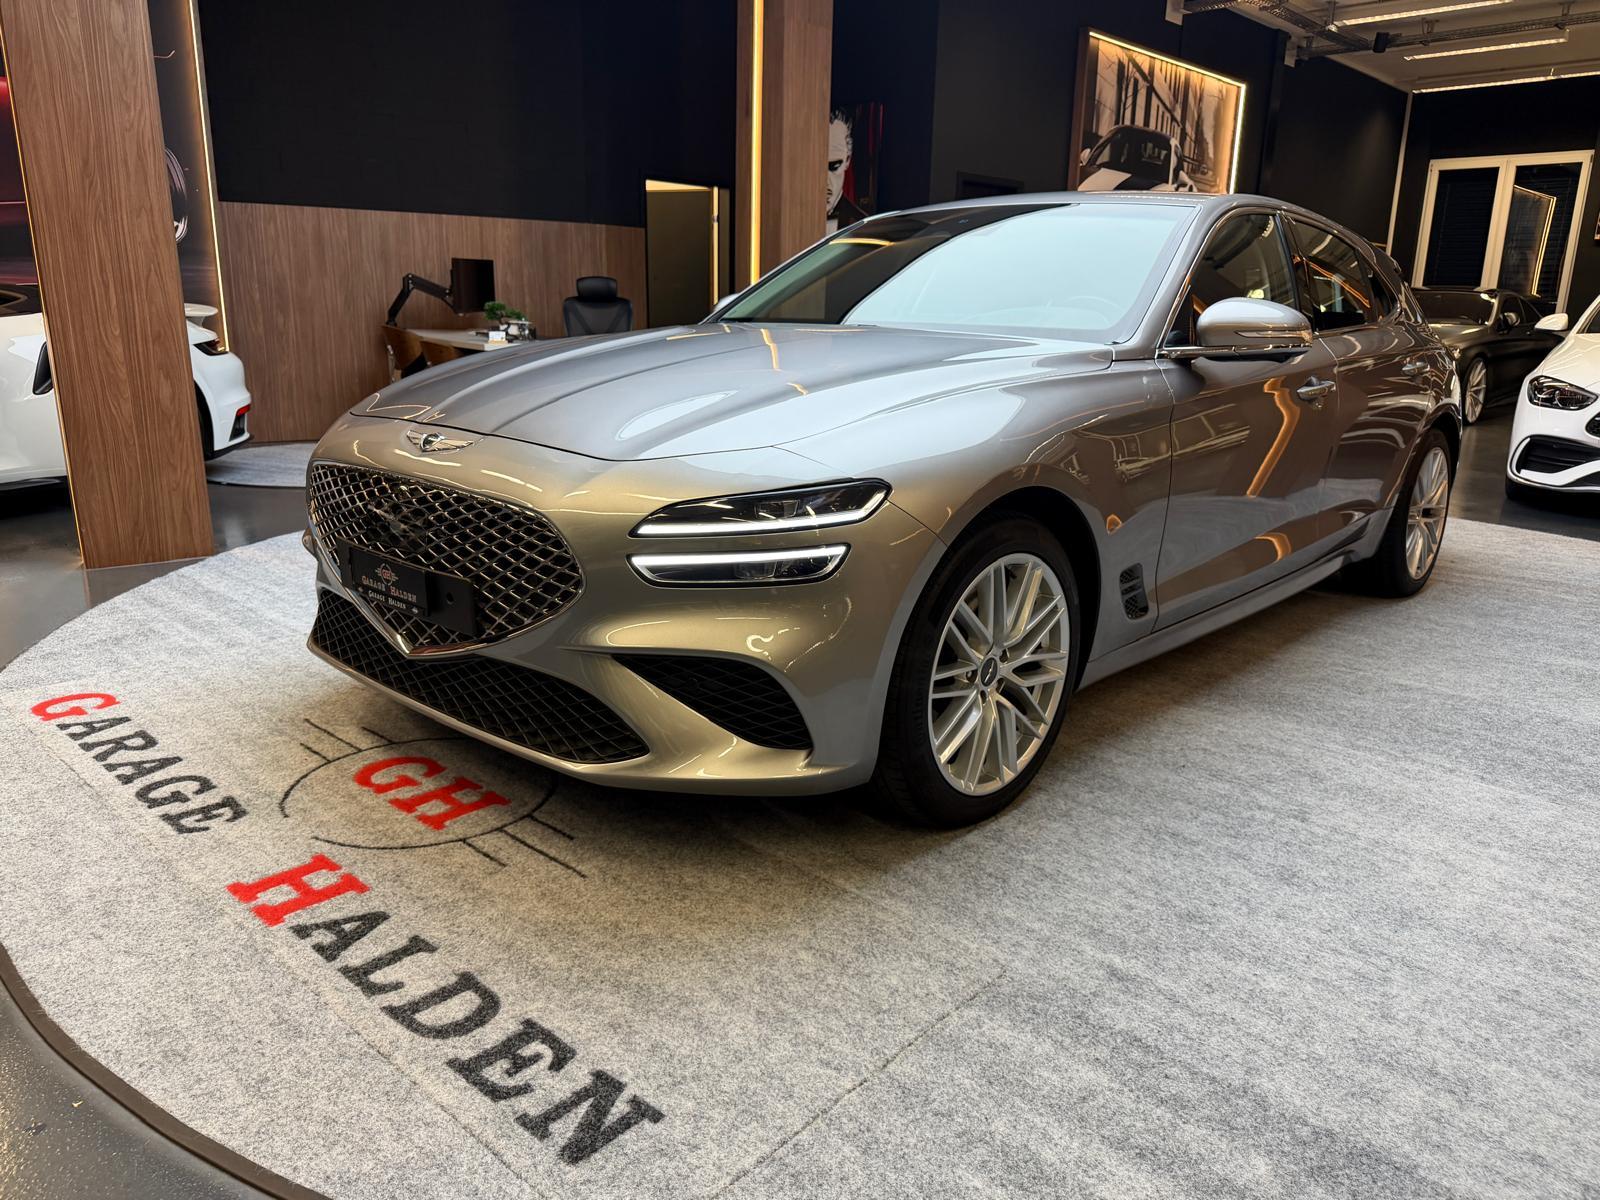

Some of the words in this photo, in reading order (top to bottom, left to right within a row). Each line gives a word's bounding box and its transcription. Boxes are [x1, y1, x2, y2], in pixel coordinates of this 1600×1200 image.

[32, 692, 247, 834] GARAGE
[226, 854, 664, 1164] HALDEN
[353, 756, 509, 830] GH
